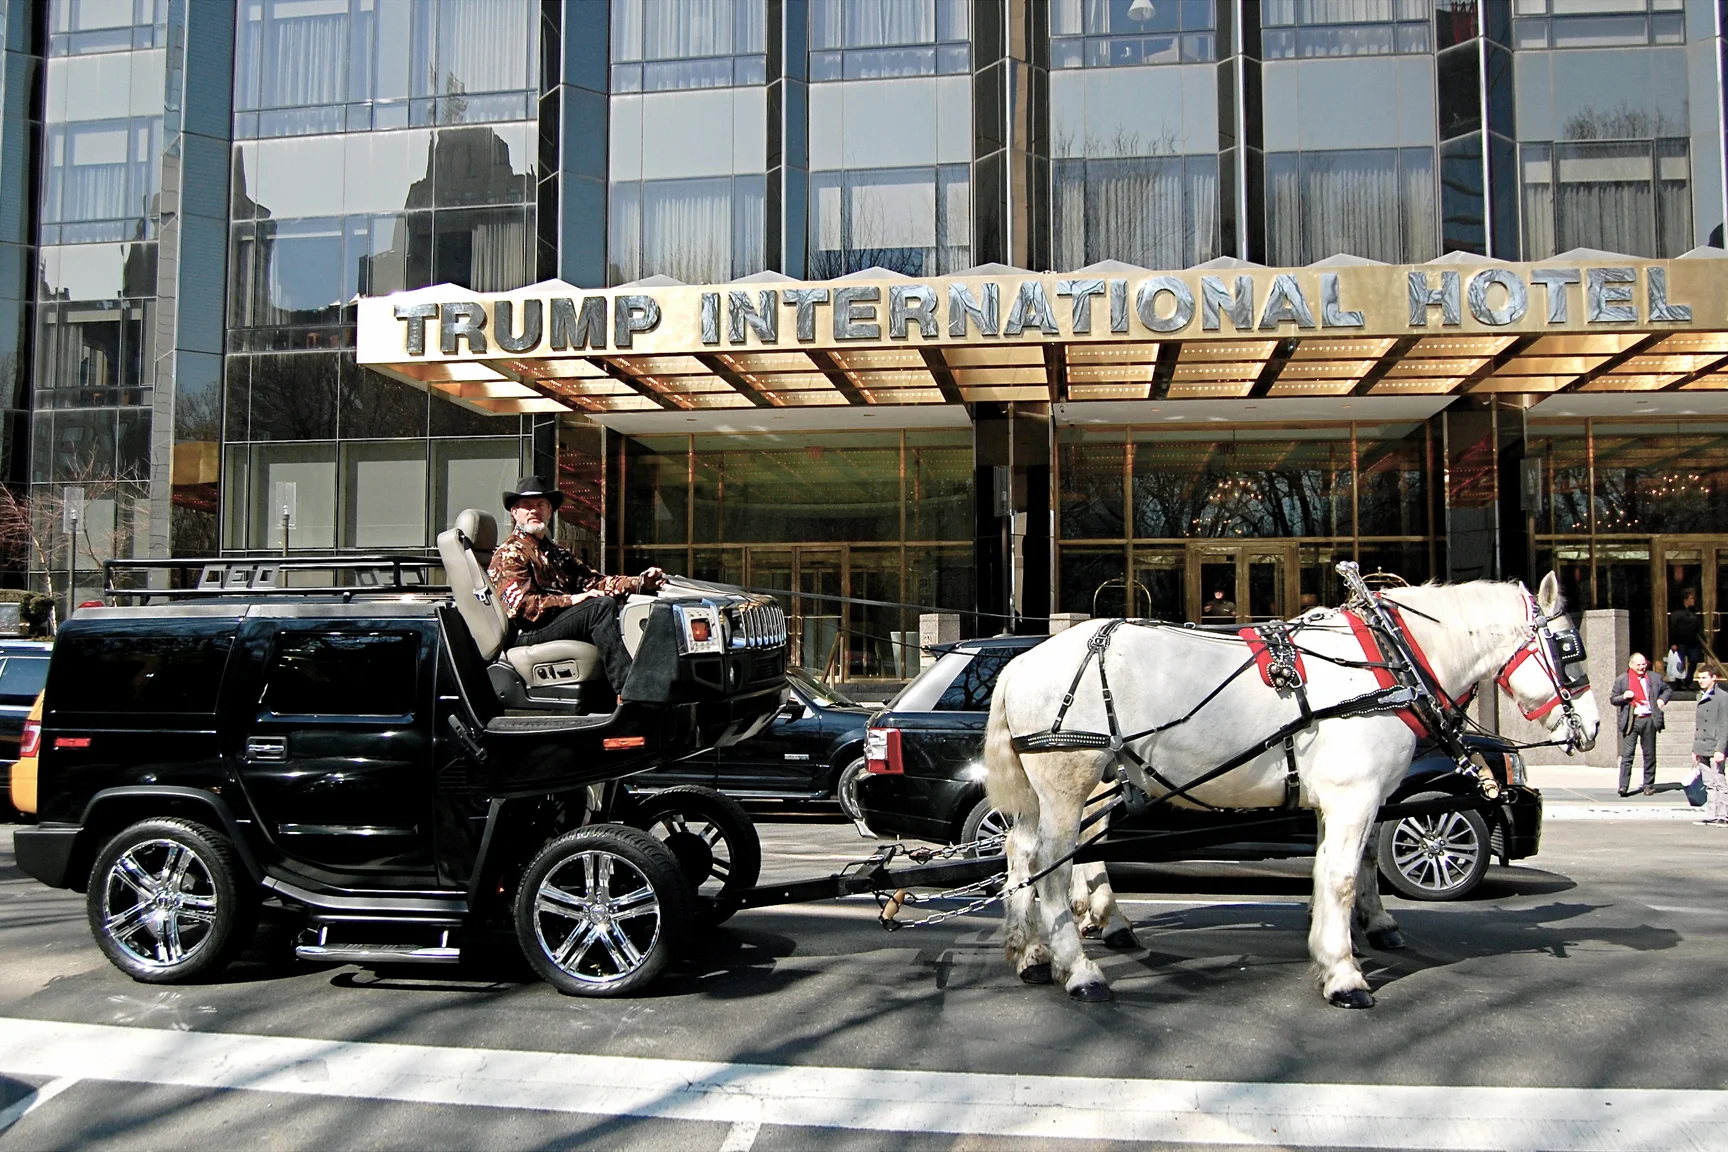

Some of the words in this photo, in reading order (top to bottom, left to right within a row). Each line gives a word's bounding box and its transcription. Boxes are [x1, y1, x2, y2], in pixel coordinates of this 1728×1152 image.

[393, 294, 662, 356] TRUMP
[701, 273, 1365, 345] INTERNATIONAL
[1408, 266, 1693, 327] HOTEL
[197, 563, 281, 589] CEO
